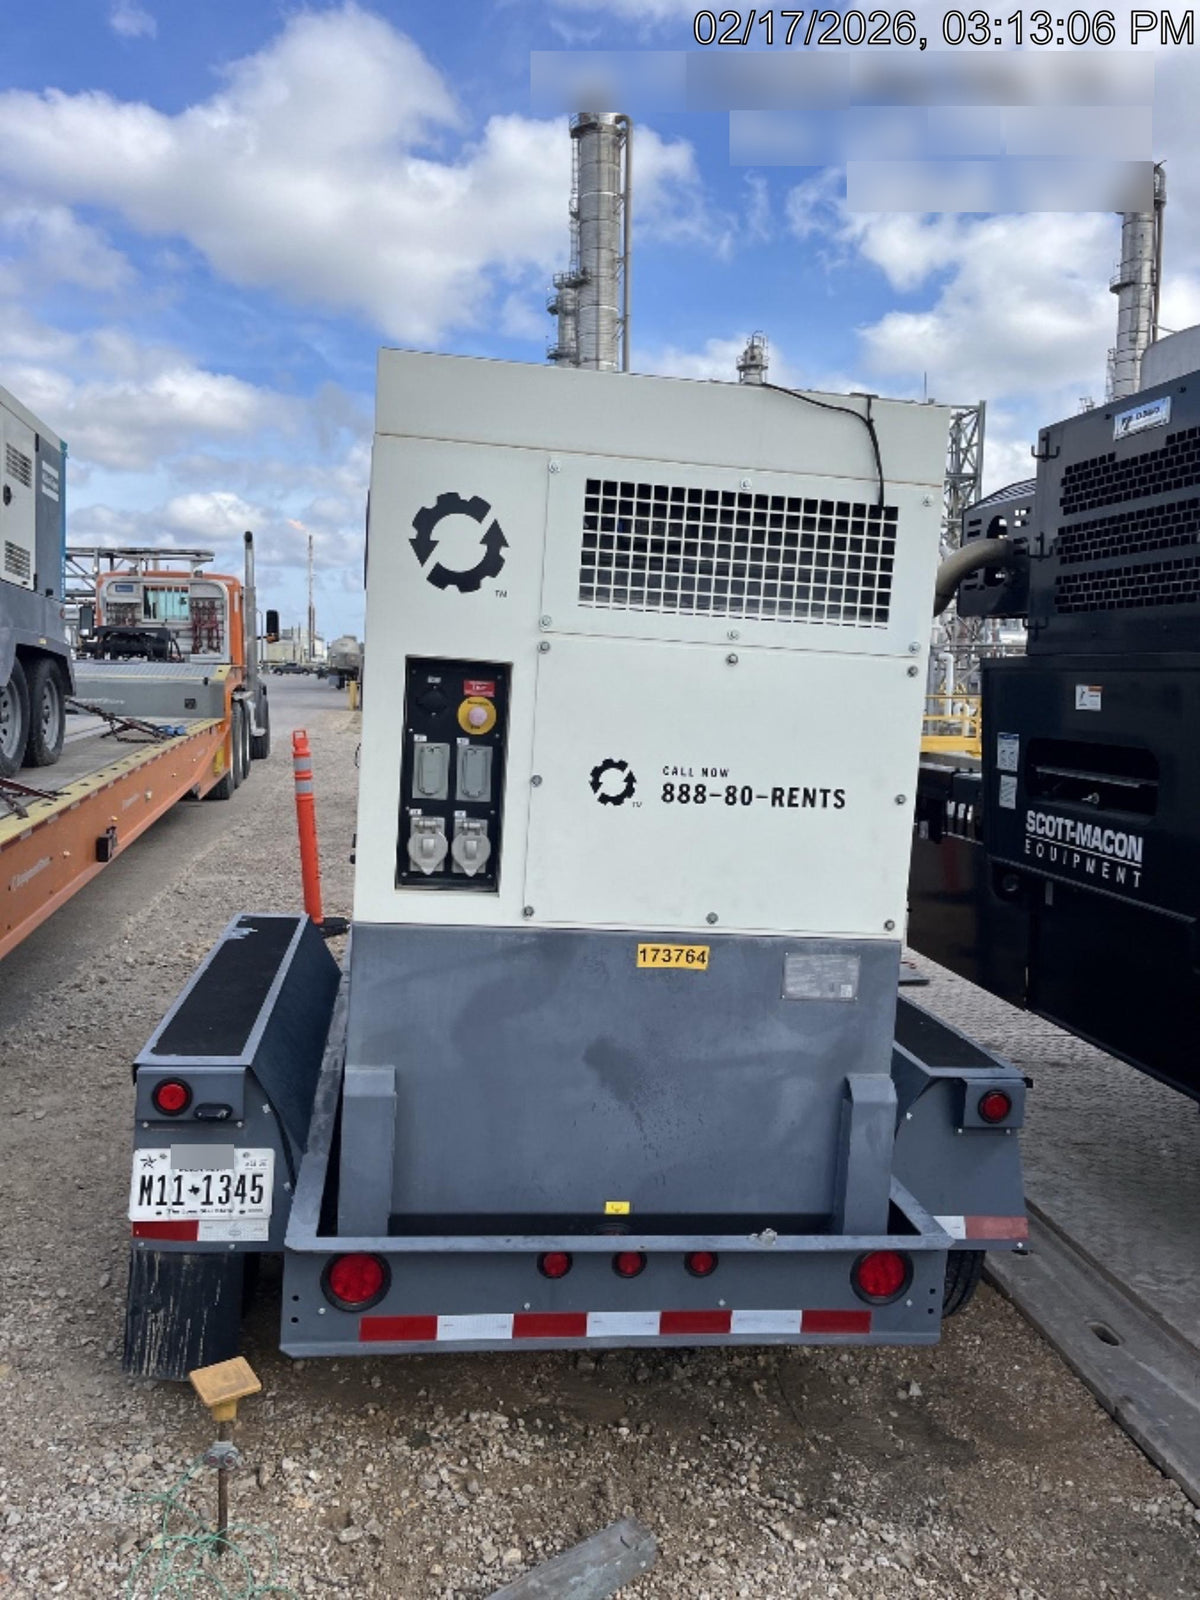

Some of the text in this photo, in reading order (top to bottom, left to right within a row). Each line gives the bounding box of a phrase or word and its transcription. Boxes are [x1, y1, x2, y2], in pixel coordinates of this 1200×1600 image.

[662, 765, 729, 778] CALL NOW
[661, 783, 846, 809] 888-80-RENTS
[1025, 810, 1142, 862] SCOTT-MACON
[1024, 838, 1141, 888] EQUIPMENT
[638, 946, 708, 966] 173764
[200, 1174, 264, 1205] 1345
